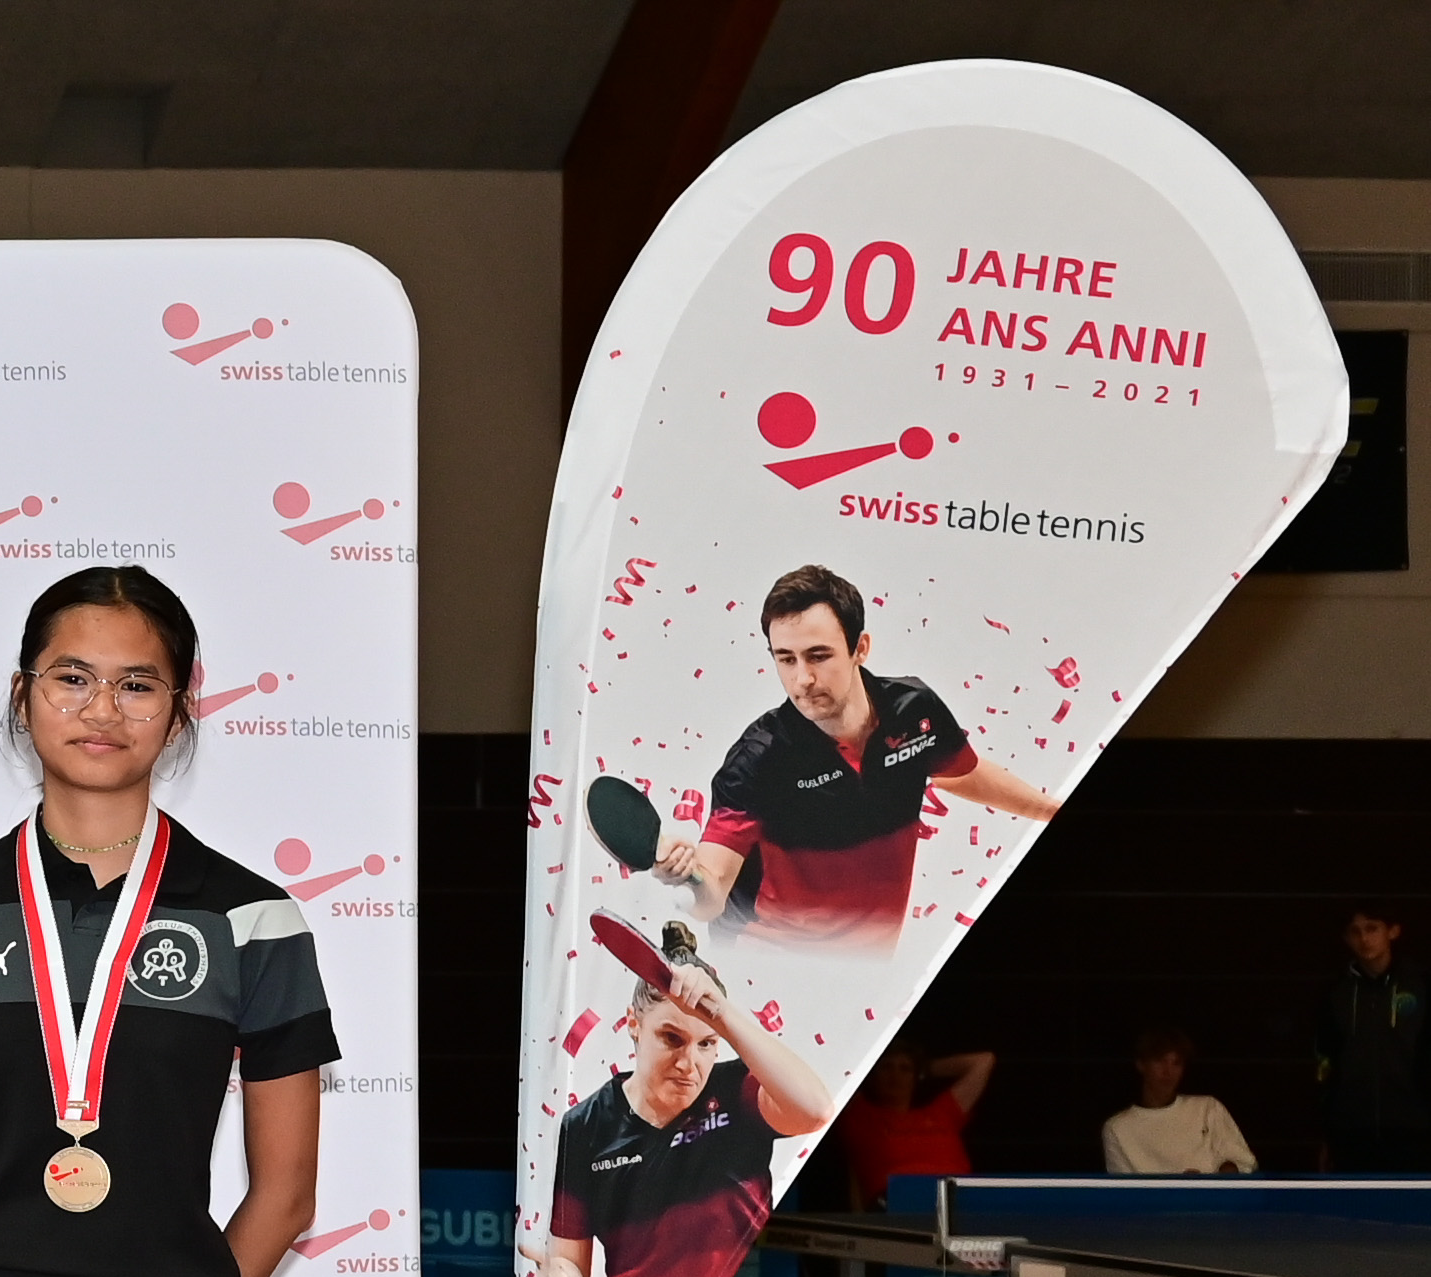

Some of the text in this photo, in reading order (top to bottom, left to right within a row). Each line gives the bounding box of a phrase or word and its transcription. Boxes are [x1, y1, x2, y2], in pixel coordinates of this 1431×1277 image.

[766, 233, 916, 335] 90
[946, 248, 1118, 298] JAHRE
[937, 307, 1207, 368] ANS ANNI
[221, 361, 283, 380] swiss
[839, 492, 939, 526] swiss
